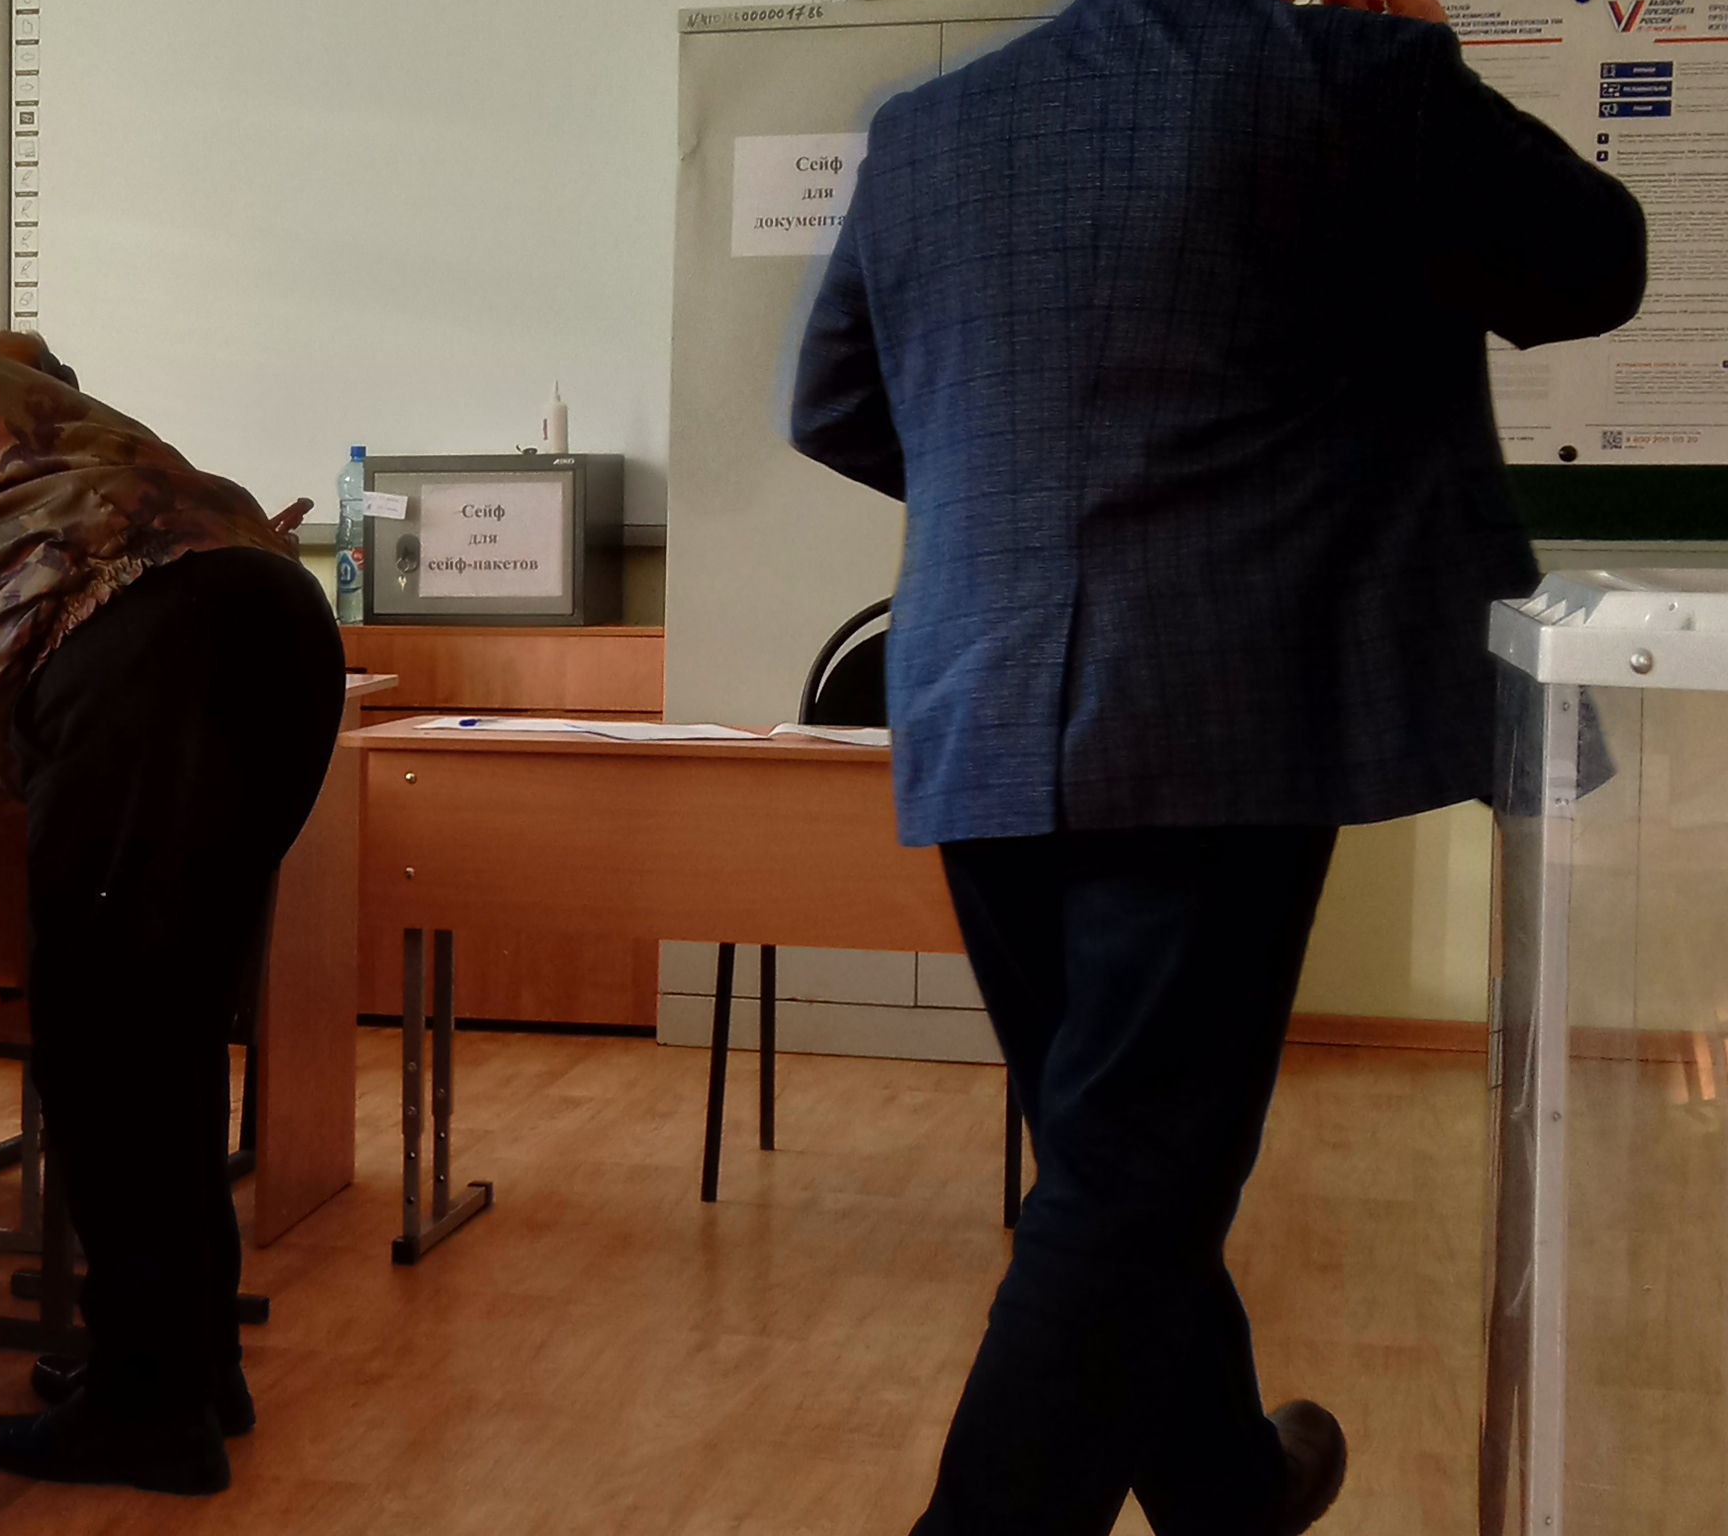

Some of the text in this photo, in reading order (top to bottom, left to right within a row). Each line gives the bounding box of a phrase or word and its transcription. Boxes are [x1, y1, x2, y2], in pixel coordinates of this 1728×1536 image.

[795, 155, 844, 175] Сейф
[802, 187, 834, 201] для
[461, 504, 506, 522] Сейф
[468, 534, 498, 547] для
[428, 557, 539, 574] сейф-пакетов
